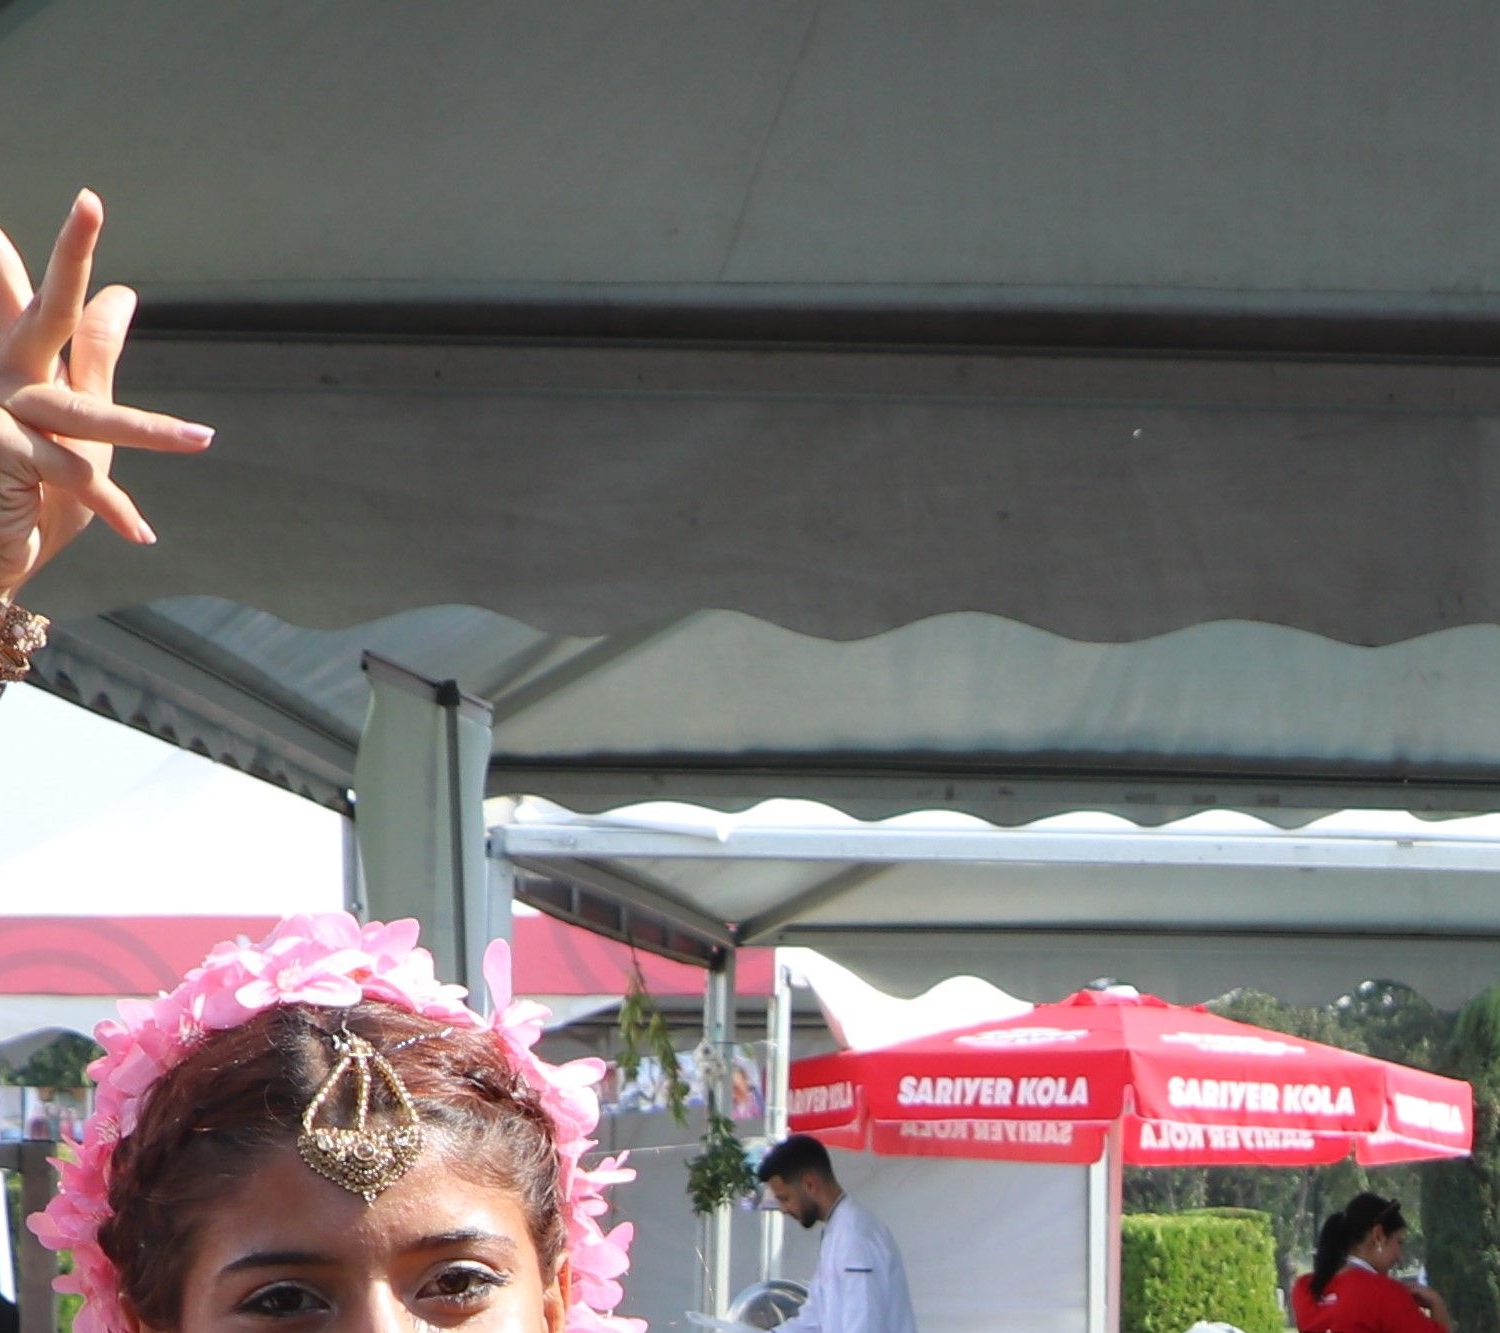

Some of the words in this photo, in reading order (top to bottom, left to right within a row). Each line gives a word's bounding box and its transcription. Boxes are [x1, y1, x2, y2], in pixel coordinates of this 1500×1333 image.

[898, 1076, 1014, 1106] SARIYER
[1017, 1076, 1089, 1106] KOLA
[1168, 1076, 1280, 1111] SARIYER
[1282, 1084, 1356, 1116] KOLA
